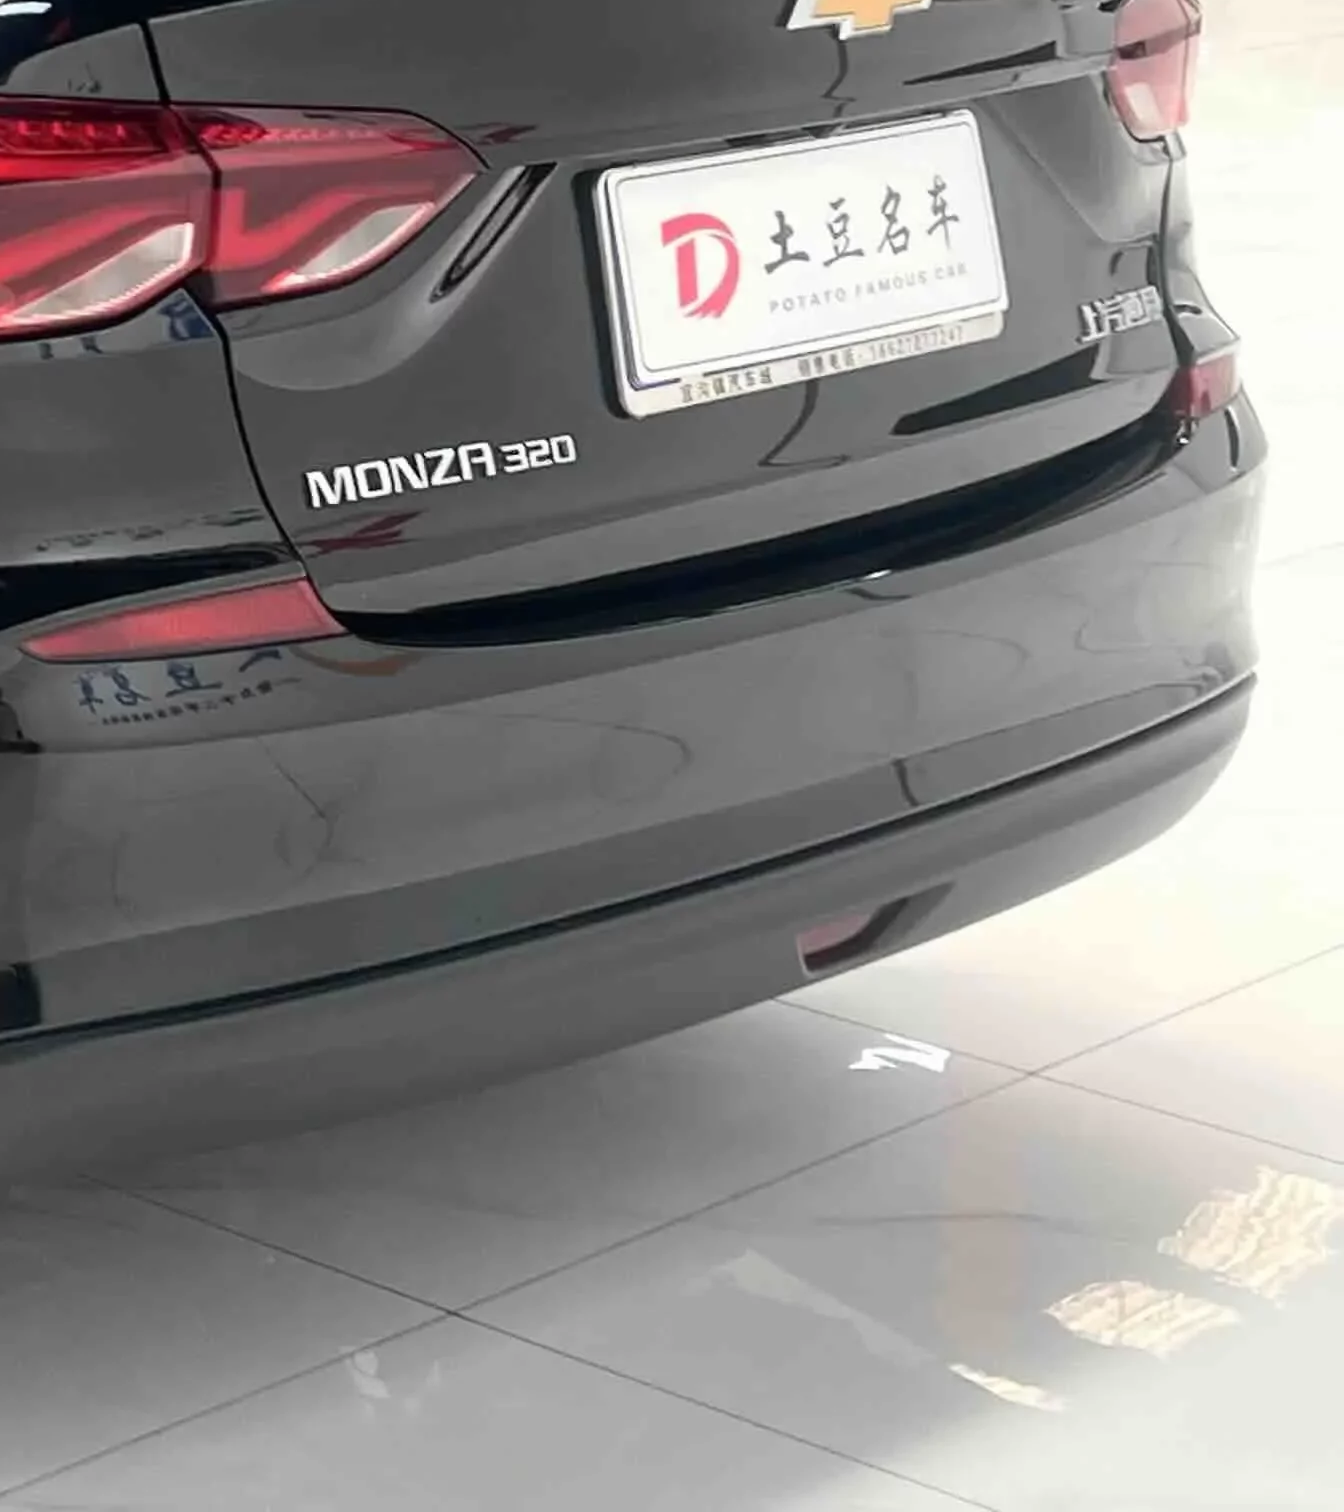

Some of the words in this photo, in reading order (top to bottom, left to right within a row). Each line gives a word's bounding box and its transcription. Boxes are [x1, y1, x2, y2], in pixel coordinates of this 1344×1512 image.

[763, 174, 960, 276] 土豆名车
[768, 287, 847, 314] POTATO
[855, 270, 928, 299] FAMOUS
[934, 262, 968, 281] CAR
[305, 441, 497, 509] MONZA
[502, 433, 578, 475] 320
